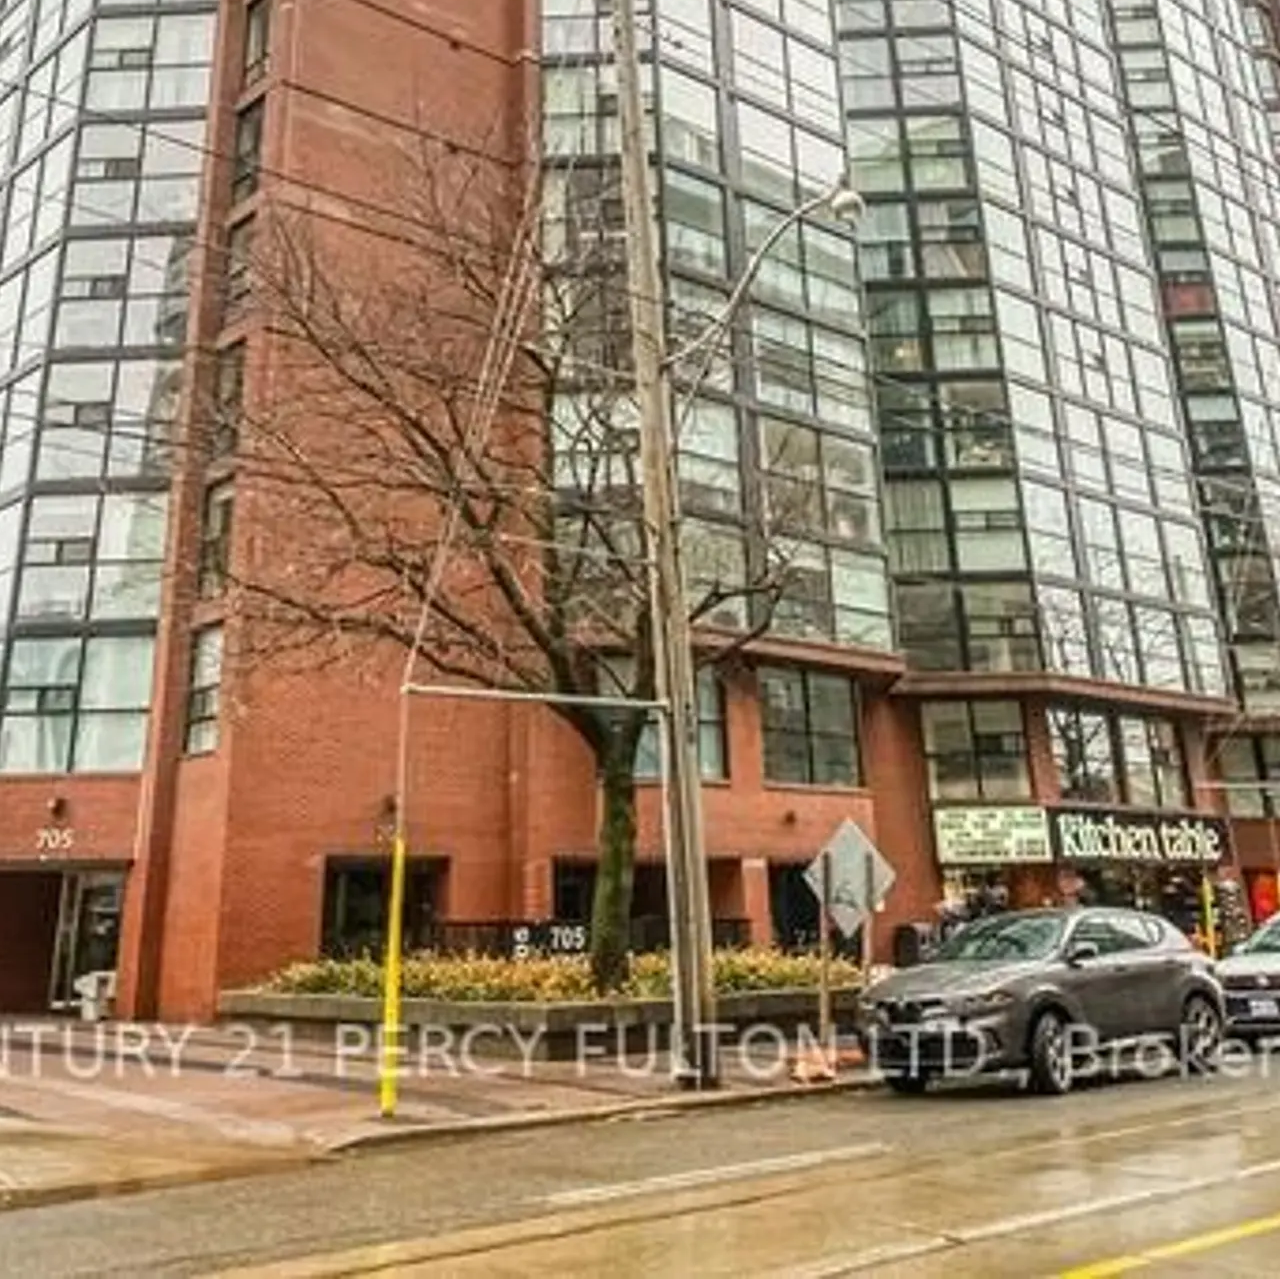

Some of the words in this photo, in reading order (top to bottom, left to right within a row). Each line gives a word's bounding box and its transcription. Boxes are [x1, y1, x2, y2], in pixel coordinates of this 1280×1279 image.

[35, 827, 75, 850] 705
[1057, 813, 1162, 861] Kitchen
[1160, 818, 1222, 861] table
[550, 925, 586, 950] 705
